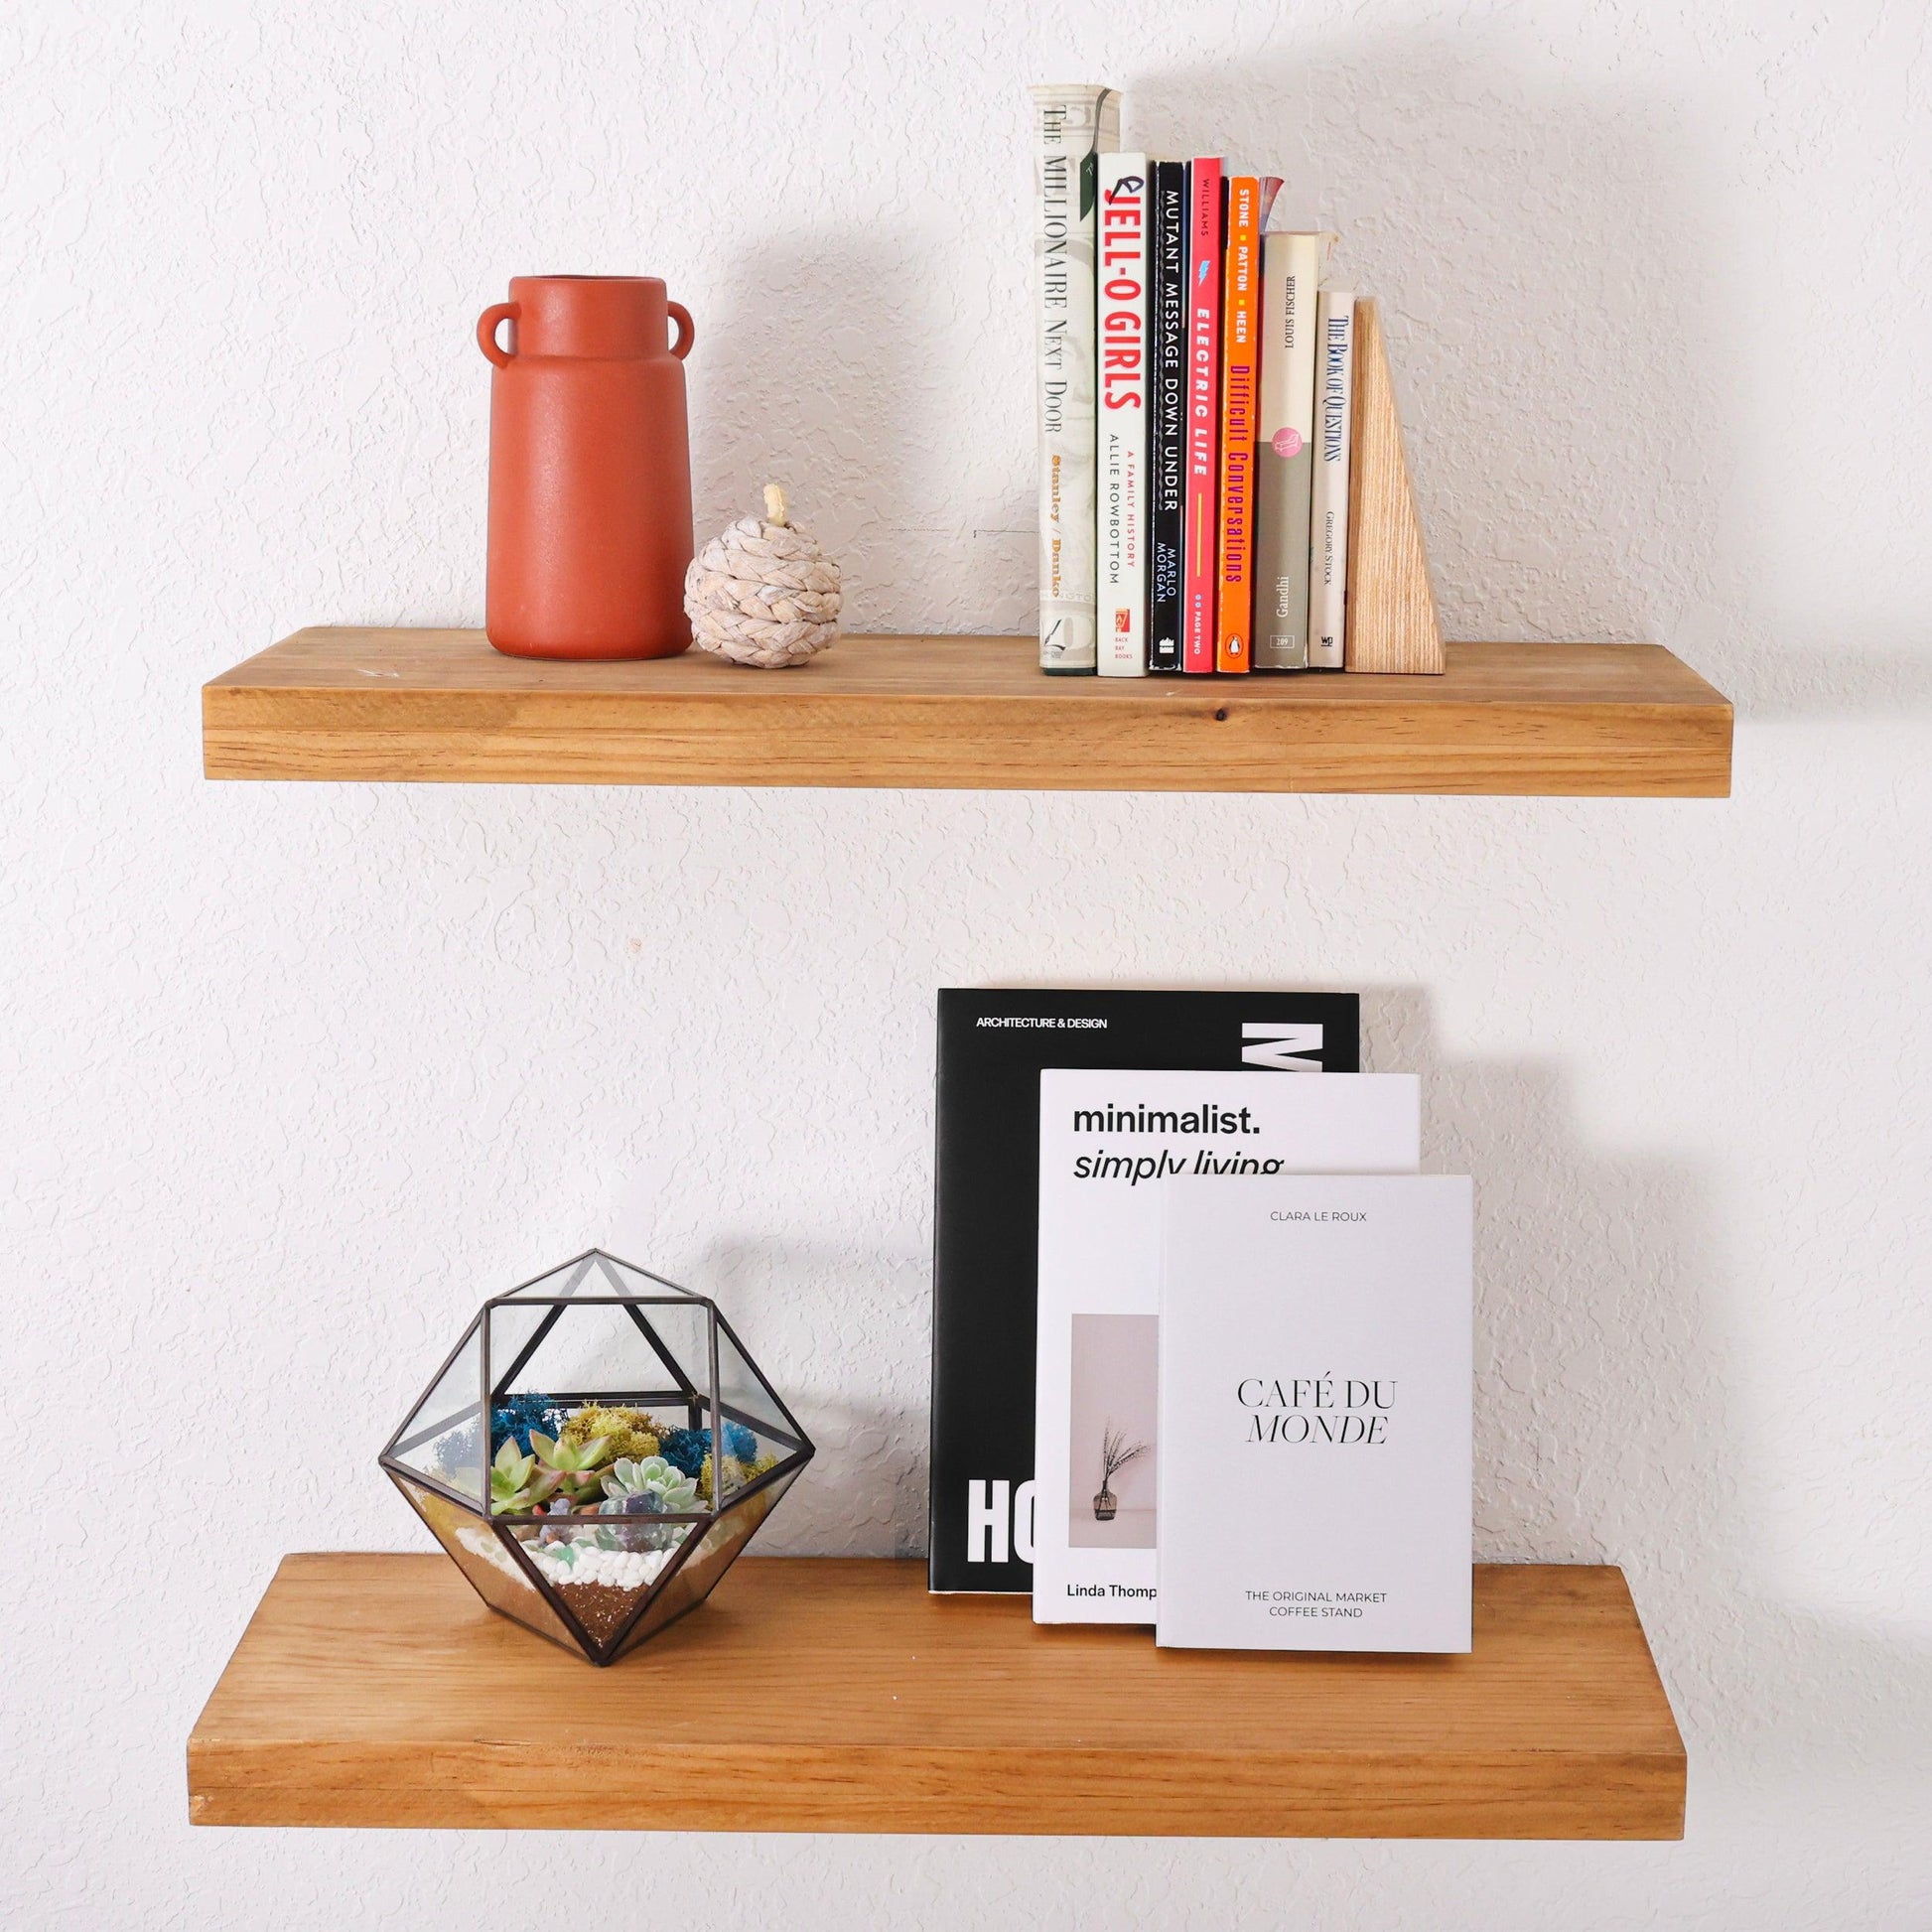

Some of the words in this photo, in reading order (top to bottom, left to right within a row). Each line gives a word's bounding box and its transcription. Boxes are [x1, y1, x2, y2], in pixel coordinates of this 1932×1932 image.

[1043, 104, 1066, 144] THE
[1200, 179, 1209, 236] WILLIAMS
[1238, 189, 1249, 227] STONE
[1043, 155, 1068, 309] MILLIONAIRE
[1104, 189, 1141, 301] JELL-O
[1166, 190, 1179, 274] MUTANT
[1237, 246, 1248, 292] PATTON
[1286, 275, 1296, 316] FISCHER
[1043, 320, 1067, 370] NEXT
[1165, 282, 1178, 368] MESSAGE
[1236, 311, 1247, 344] HEEN
[1285, 319, 1295, 348] LOUIS
[1327, 315, 1349, 341] THE
[1104, 311, 1142, 410] GIRLS
[1194, 308, 1210, 418] ELECTRIC
[1325, 343, 1348, 380] BOOK
[1044, 381, 1068, 433] DOOR
[1165, 378, 1178, 436] DOWN
[1229, 365, 1250, 442] Difficult
[1325, 381, 1344, 395] OF
[1193, 428, 1208, 476] LIFE
[1322, 395, 1347, 463] QUESTIONS
[1109, 434, 1120, 476] ALLIE
[1050, 455, 1062, 523] Stanley
[1165, 447, 1178, 511] UNDER
[1109, 483, 1120, 584] ROWBOTTOM
[1225, 452, 1249, 583] Conversations
[1325, 510, 1335, 554] GREGORY
[1127, 514, 1136, 568] HISTORY
[1051, 539, 1062, 598] Danko
[1157, 542, 1167, 603] MORGAN
[1167, 548, 1177, 597] MARLO
[1323, 554, 1334, 586] STOCK
[1276, 576, 1290, 619] Gandhi
[976, 1017, 1055, 1029] ARCHITECTURE
[1057, 1018, 1065, 1028] &
[1066, 1018, 1107, 1030] DESIGN
[1073, 1103, 1260, 1134] minimalist.
[1073, 1149, 1186, 1185] simply
[1270, 1211, 1311, 1221] CLARA
[1313, 1211, 1328, 1221] LE
[1331, 1211, 1367, 1222] ROUX
[1237, 1370, 1335, 1408] CAFÉ
[1343, 1380, 1399, 1410] DU
[1244, 1414, 1389, 1445] MONDE
[1067, 1584, 1105, 1597] Linda
[1245, 1590, 1270, 1600] THE
[1272, 1590, 1332, 1602] ORIGINAL
[1335, 1592, 1388, 1603] MARKET
[1269, 1606, 1318, 1617] COFFEE
[1321, 1607, 1363, 1618] STAND
